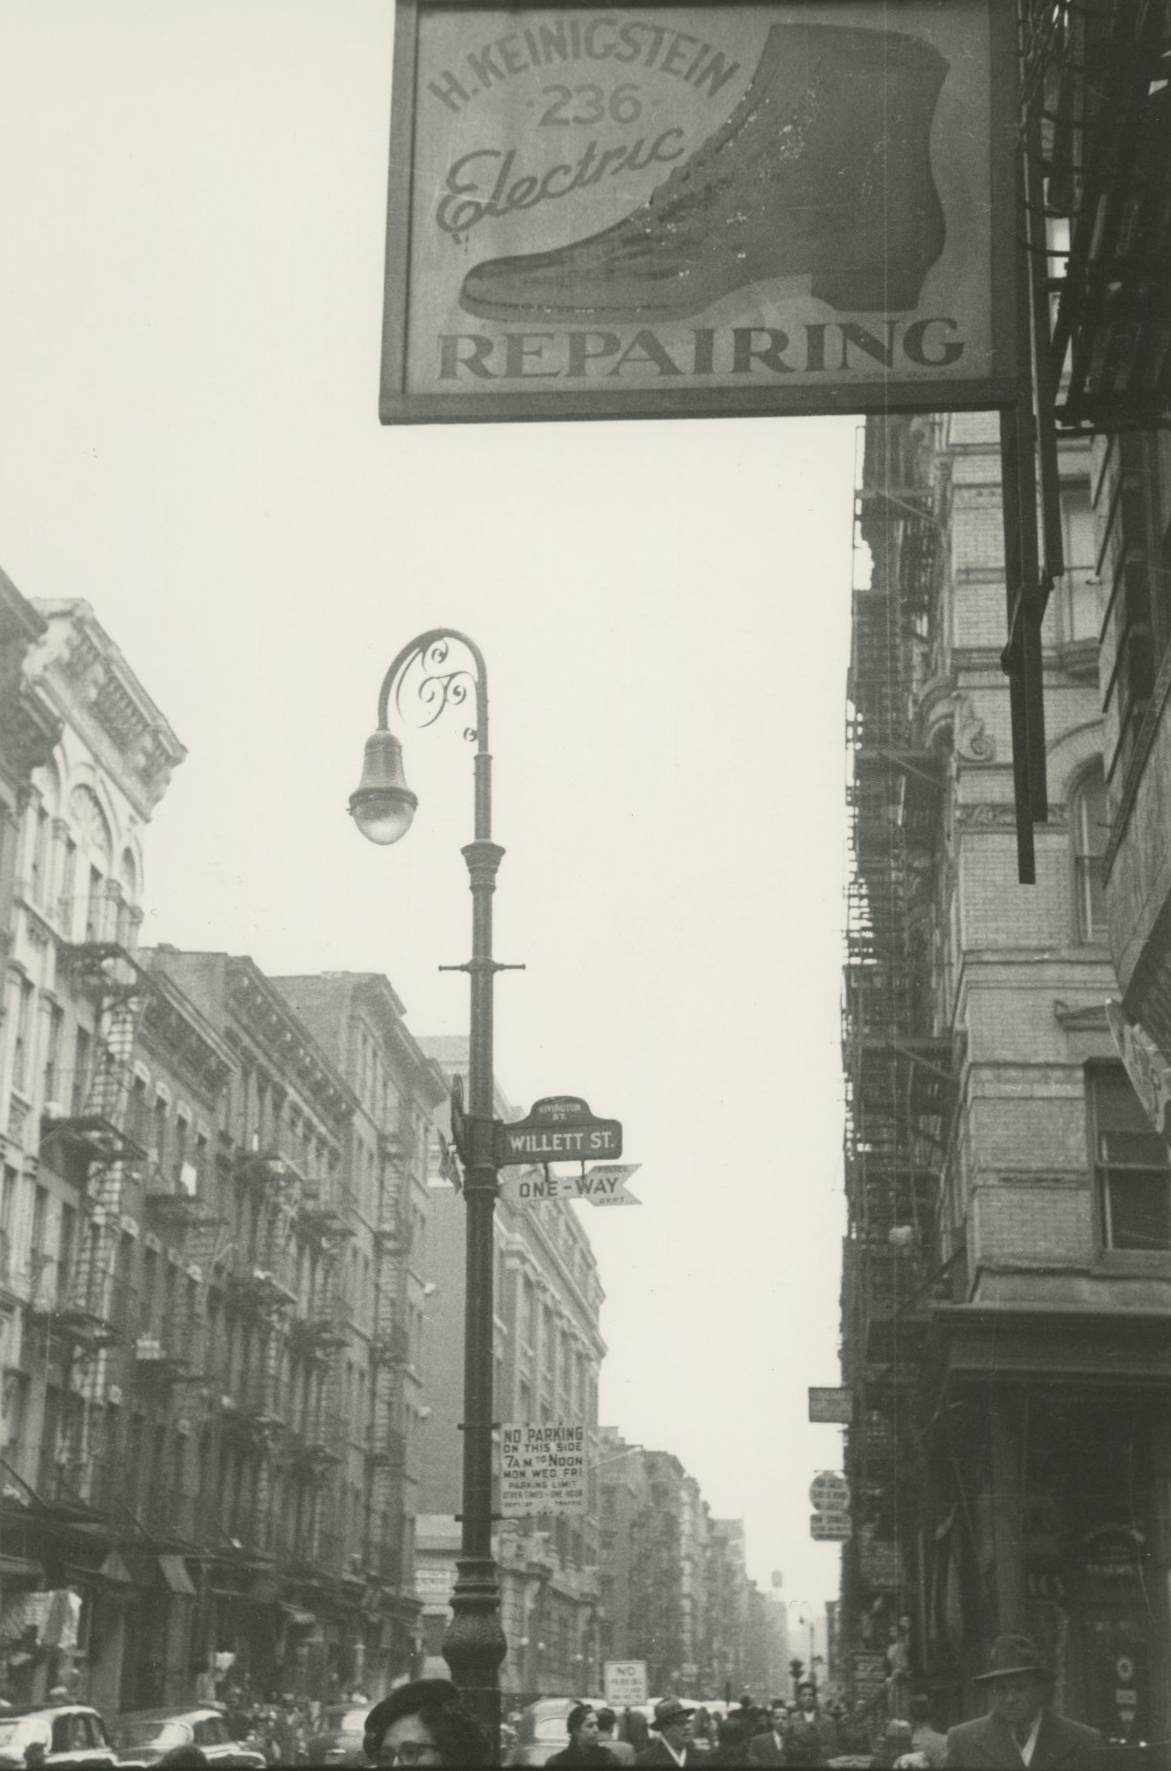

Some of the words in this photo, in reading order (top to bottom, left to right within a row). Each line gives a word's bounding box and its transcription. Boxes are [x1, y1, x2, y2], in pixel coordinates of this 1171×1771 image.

[466, 17, 741, 98] KEINIGSTEIN
[538, 83, 642, 126] 236
[435, 127, 686, 234] Electric
[436, 317, 966, 380] REPAIRING
[510, 1133, 583, 1152] WILLETT
[590, 1131, 616, 1149] ST.
[503, 1444, 519, 1454] ON
[524, 1443, 551, 1453] THIS
[556, 1442, 582, 1453] SIDE
[504, 1429, 521, 1444] NO
[528, 1426, 583, 1443] PARKING
[552, 1481, 578, 1490] LIMIT
